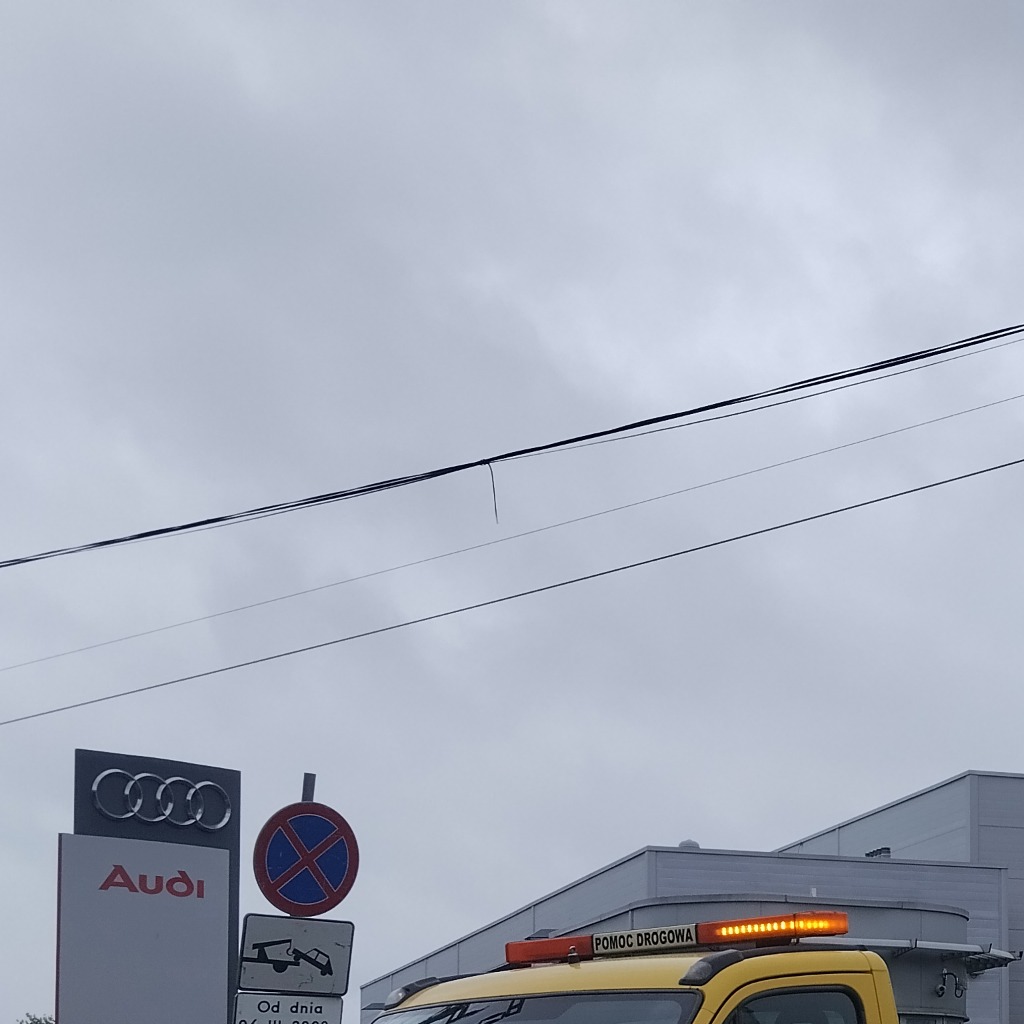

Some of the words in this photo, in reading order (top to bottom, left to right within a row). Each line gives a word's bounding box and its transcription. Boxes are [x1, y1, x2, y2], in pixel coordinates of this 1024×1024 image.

[98, 864, 205, 899] Audi
[594, 934, 634, 951] POMOC
[636, 927, 694, 947] DROGOWA
[257, 1000, 280, 1013] Od
[290, 1001, 323, 1014] dnia
